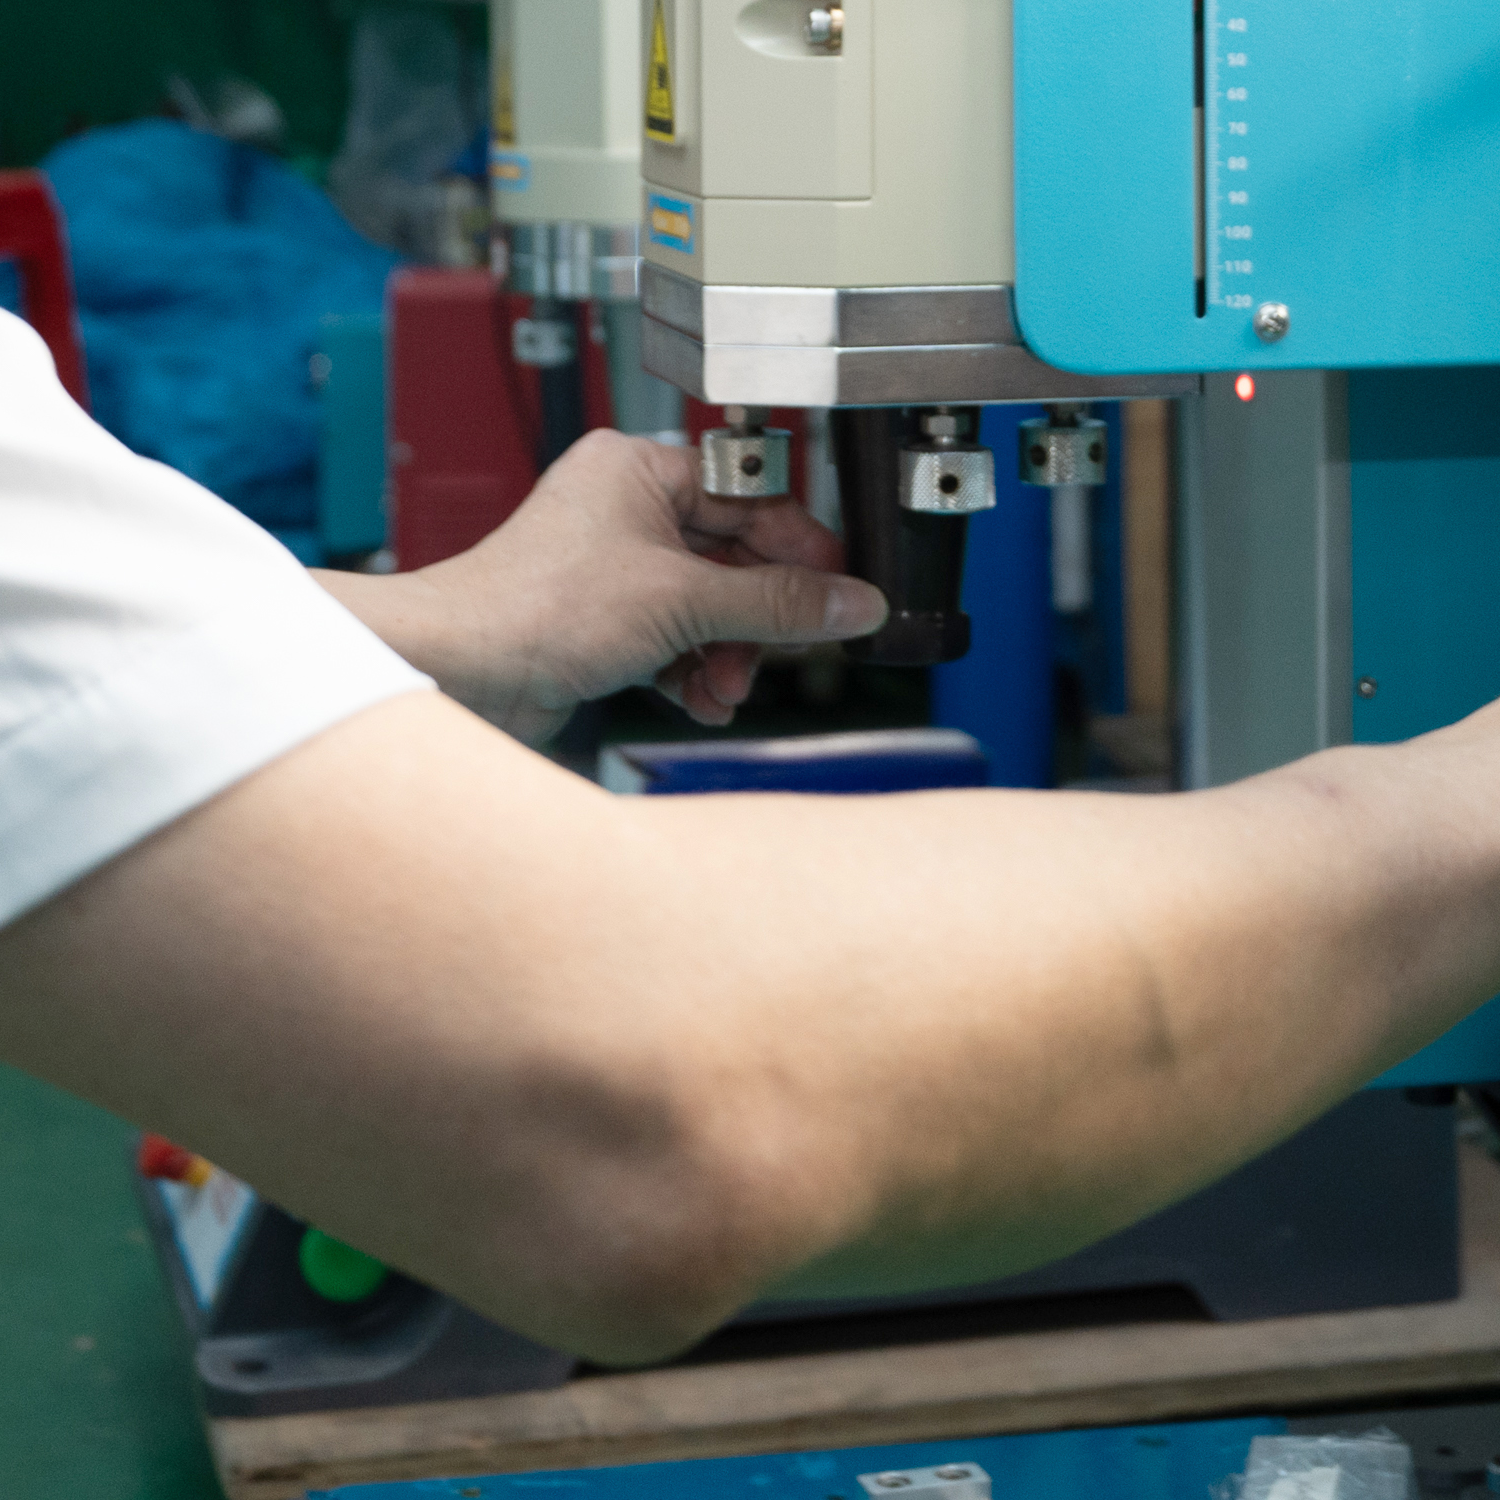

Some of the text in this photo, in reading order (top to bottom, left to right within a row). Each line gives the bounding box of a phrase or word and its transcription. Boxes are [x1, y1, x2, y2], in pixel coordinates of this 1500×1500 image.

[1227, 18, 1247, 32] 40
[1227, 53, 1247, 67] 50
[1227, 87, 1247, 101] 60
[1229, 122, 1248, 135] 70
[1228, 157, 1248, 170] 80
[1228, 191, 1248, 204] 90
[1225, 225, 1252, 239] 100
[1225, 260, 1253, 274] 110
[1224, 295, 1253, 309] 120
